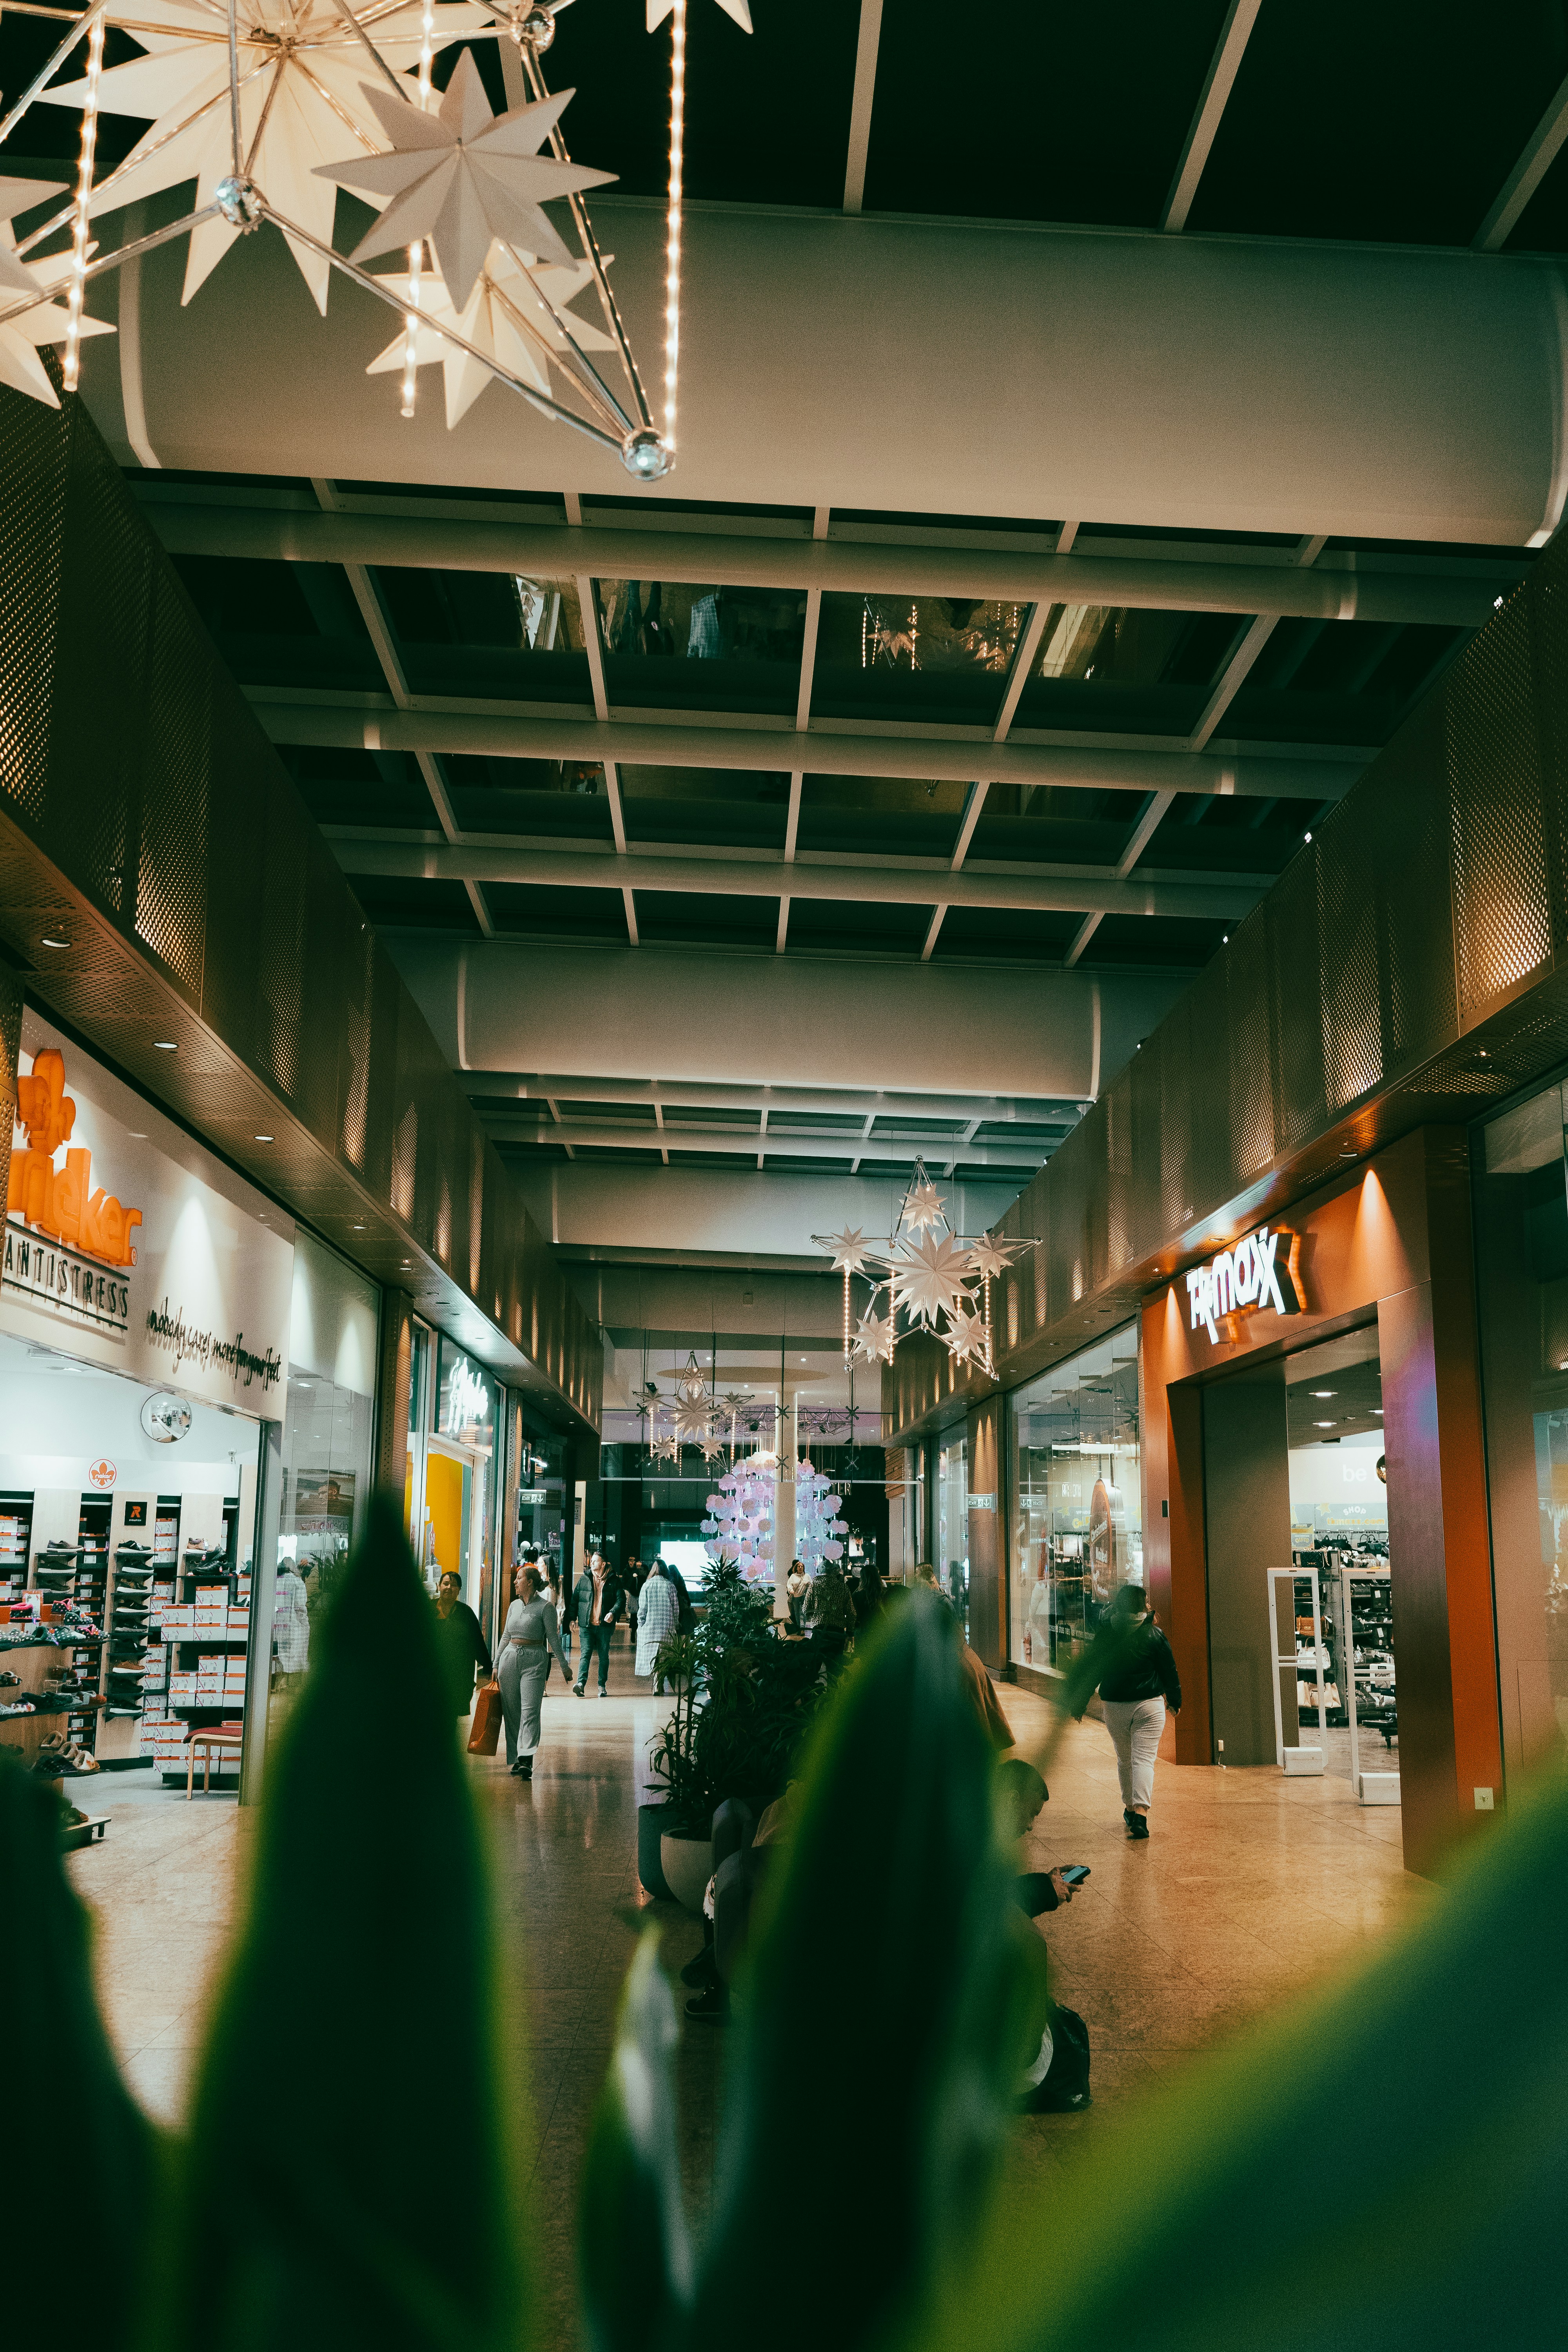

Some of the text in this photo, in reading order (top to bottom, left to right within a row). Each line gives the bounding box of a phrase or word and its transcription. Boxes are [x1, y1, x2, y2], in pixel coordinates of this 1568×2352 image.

[5, 1234, 128, 1318] ANTISTRESS
[150, 1296, 186, 1359] nobody
[188, 1326, 212, 1359] cares
[212, 1337, 236, 1364] more
[265, 1347, 281, 1391] feet
[1343, 1464, 1367, 1482] be
[1343, 1506, 1367, 1515] SHOP
